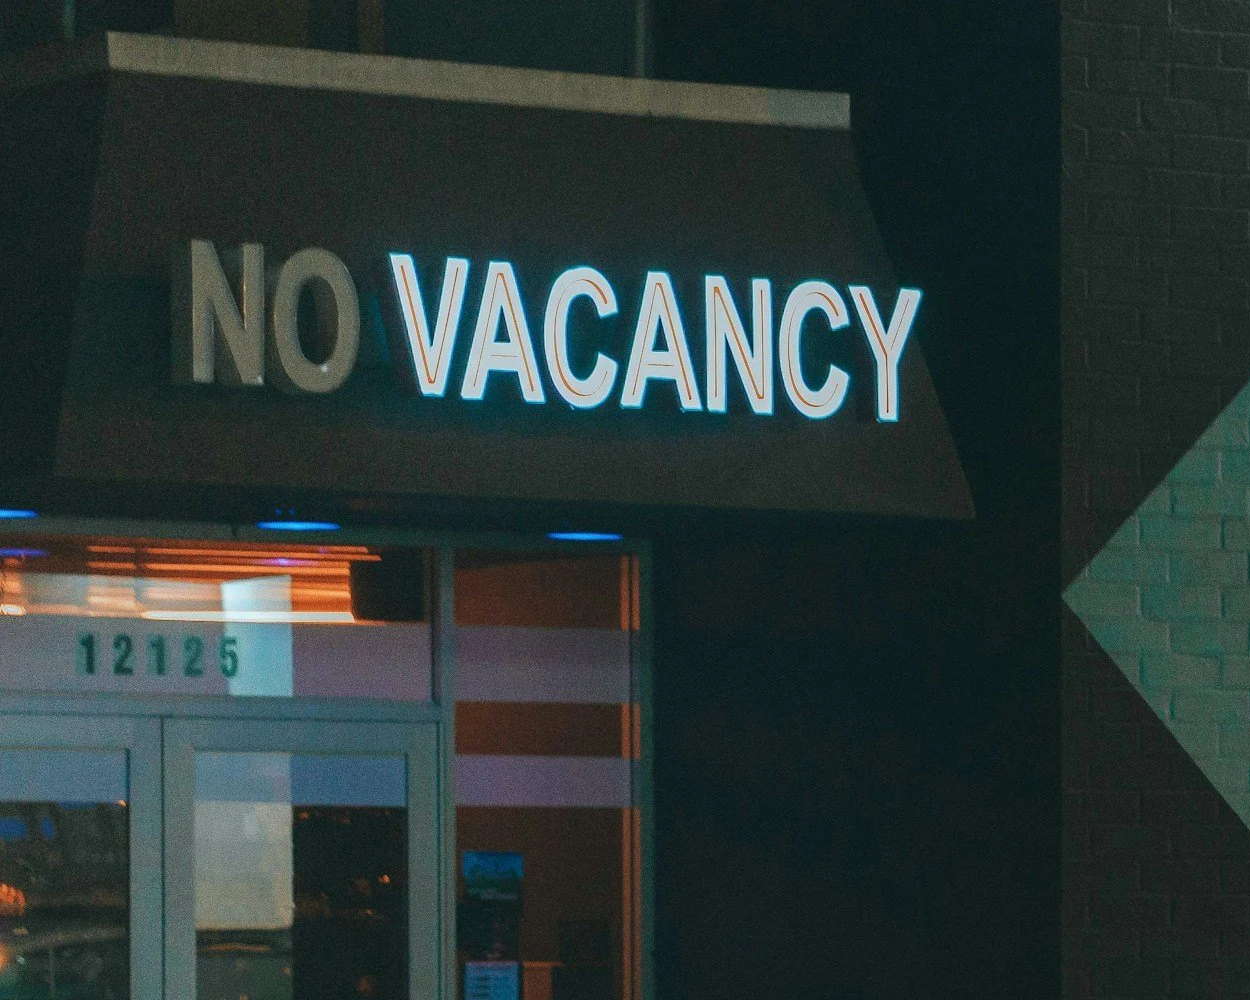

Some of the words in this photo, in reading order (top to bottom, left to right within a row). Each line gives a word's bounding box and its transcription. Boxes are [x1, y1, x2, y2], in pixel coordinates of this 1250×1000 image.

[191, 240, 361, 394] NO
[388, 252, 923, 423] VACANCY
[79, 632, 239, 678] 12125
